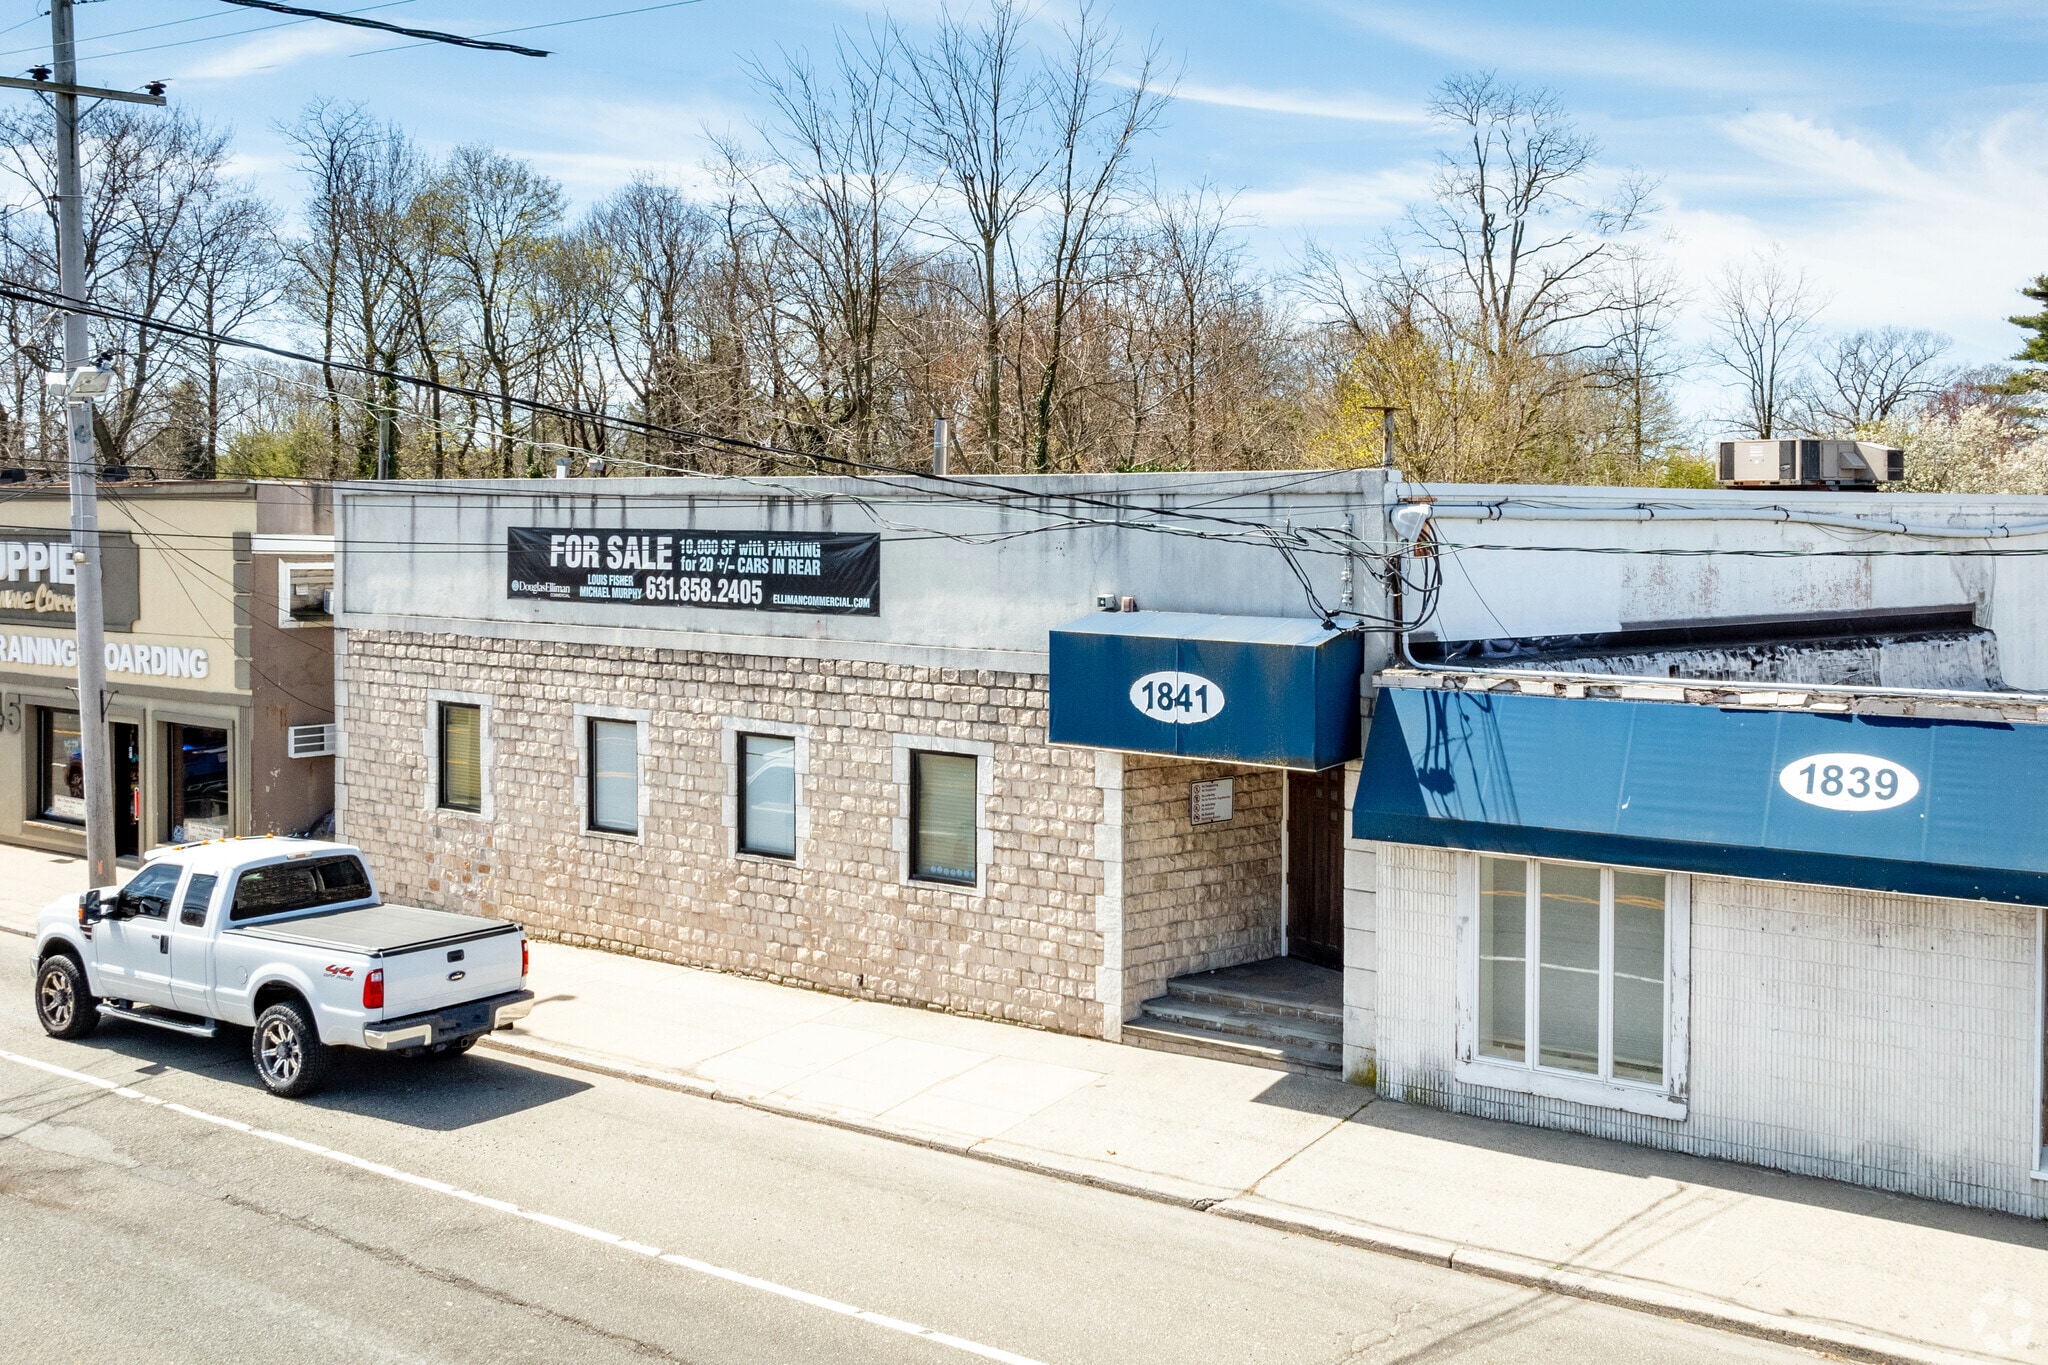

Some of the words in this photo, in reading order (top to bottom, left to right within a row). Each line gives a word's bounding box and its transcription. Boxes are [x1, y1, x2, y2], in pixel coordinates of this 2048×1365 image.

[550, 535, 600, 568] FOR
[606, 535, 673, 570] SALE
[679, 539, 718, 556] 10,000
[721, 539, 736, 555] SF
[738, 540, 764, 556] with
[768, 540, 821, 558] PARKING
[680, 556, 697, 571] for
[699, 556, 714, 572] 20
[737, 557, 769, 574] CARS
[772, 558, 785, 574] IN
[788, 558, 821, 576] REAR
[587, 574, 607, 585] LOUIS
[608, 574, 634, 587] FISHER
[646, 576, 763, 605] 631.858.2405
[579, 586, 610, 598] MICHAEL
[612, 587, 642, 599] MURPHY
[773, 593, 871, 608] ELLIMANCOMMERCIAL.COM
[1141, 681, 1208, 714] 1841
[1799, 763, 1899, 801] 1839
